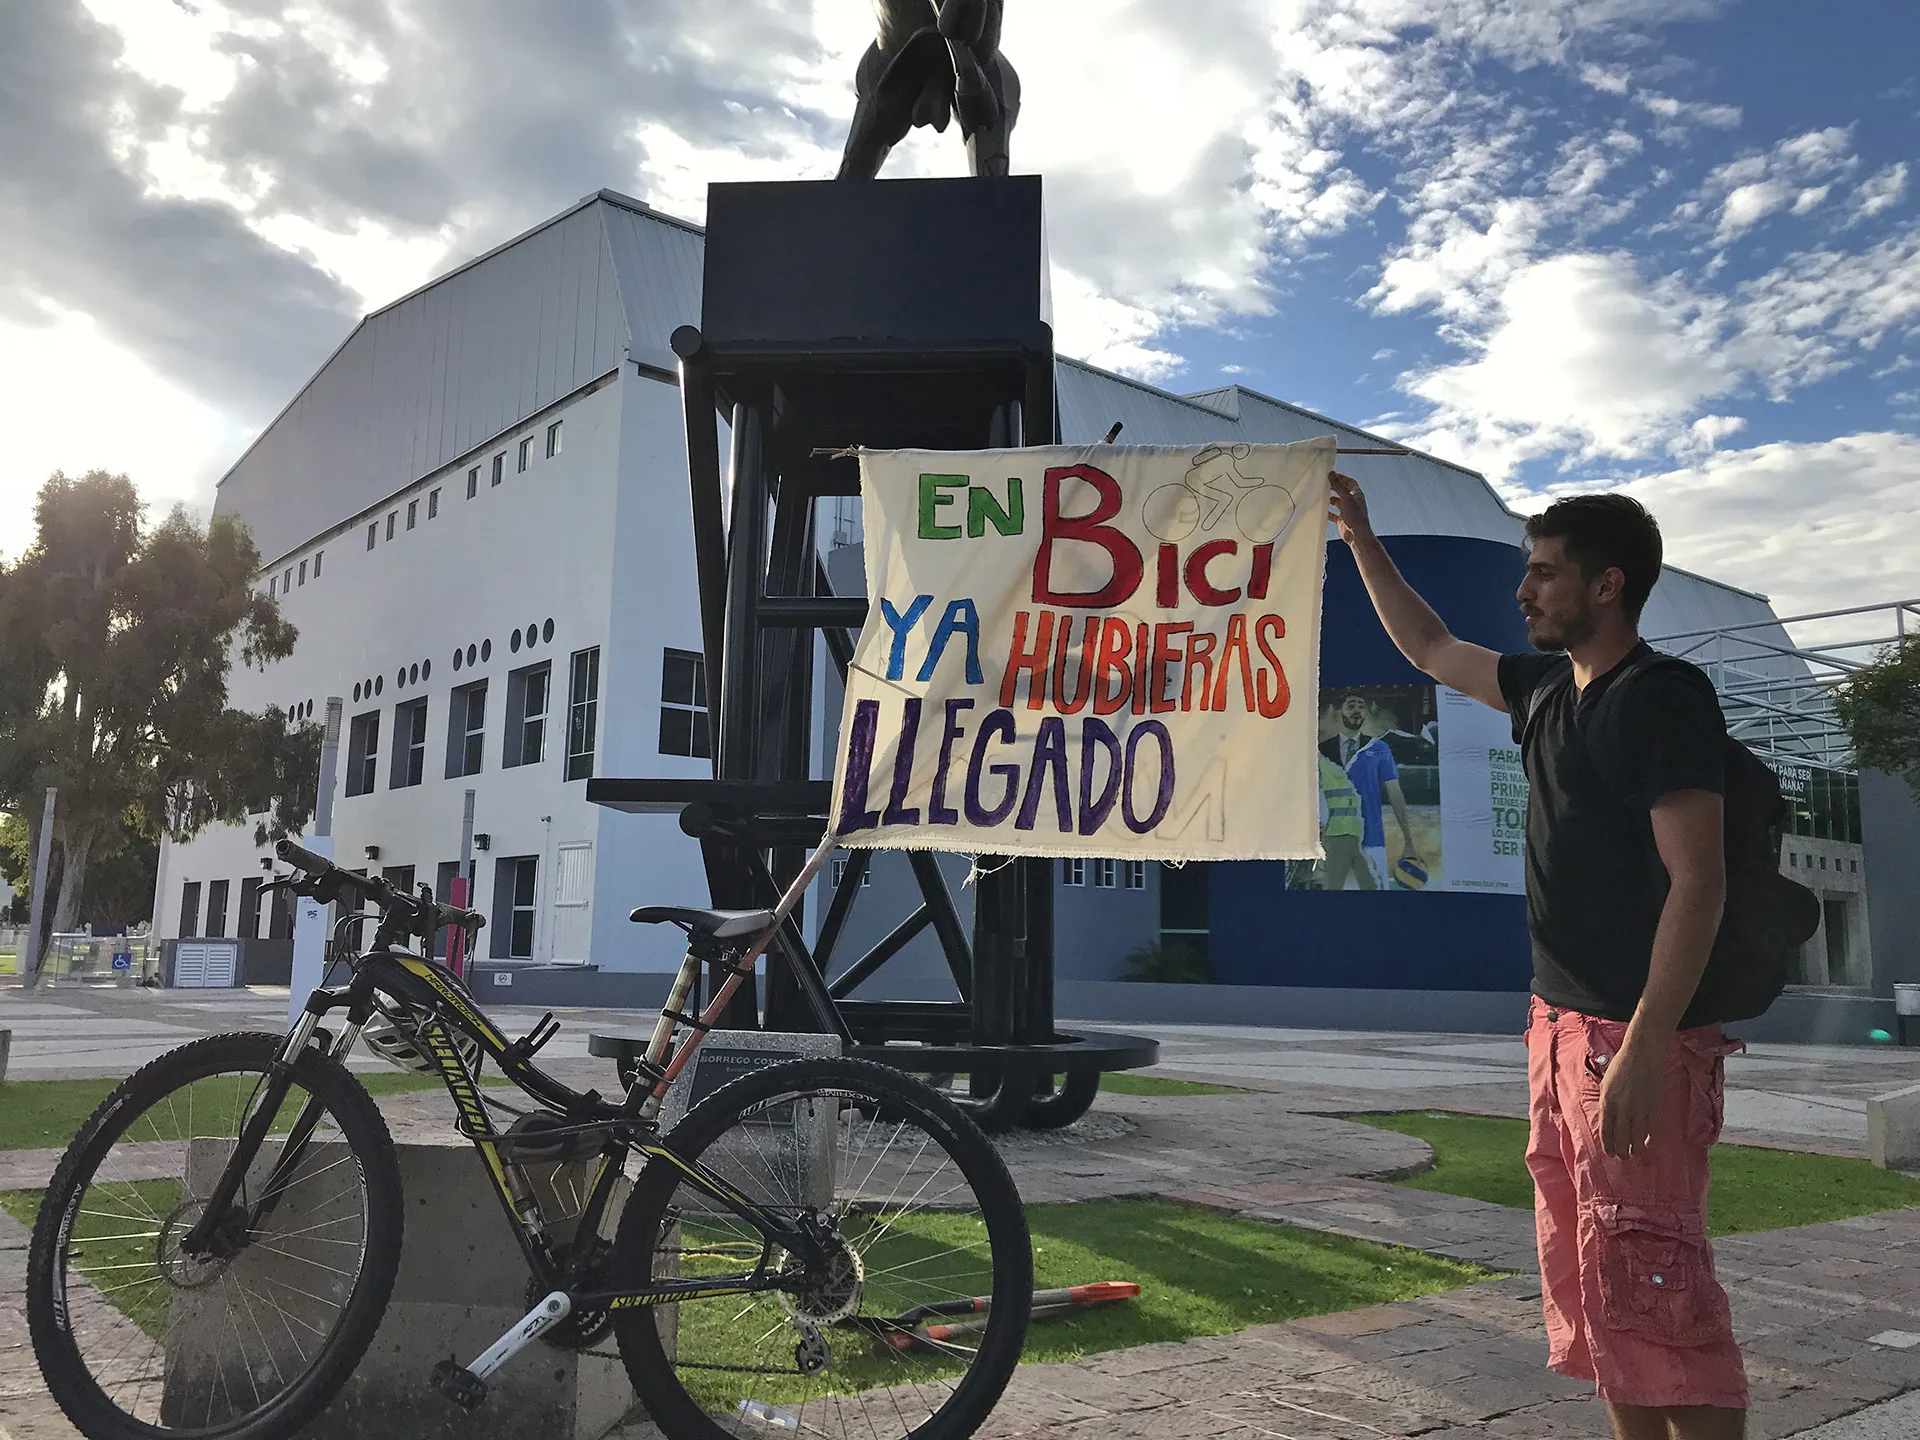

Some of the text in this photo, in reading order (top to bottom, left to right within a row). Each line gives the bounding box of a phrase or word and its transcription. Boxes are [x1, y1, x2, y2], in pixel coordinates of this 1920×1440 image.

[917, 473, 1024, 540] EN
[880, 594, 1291, 719] YA HUBIERAS
[835, 697, 1175, 836] LLEGADO
[1488, 748, 1521, 764] PARA
[1490, 771, 1508, 781] SER
[1492, 840, 1519, 856] SER
[424, 973, 482, 1028] HARDROCK
[699, 1055, 751, 1065] BORREGO
